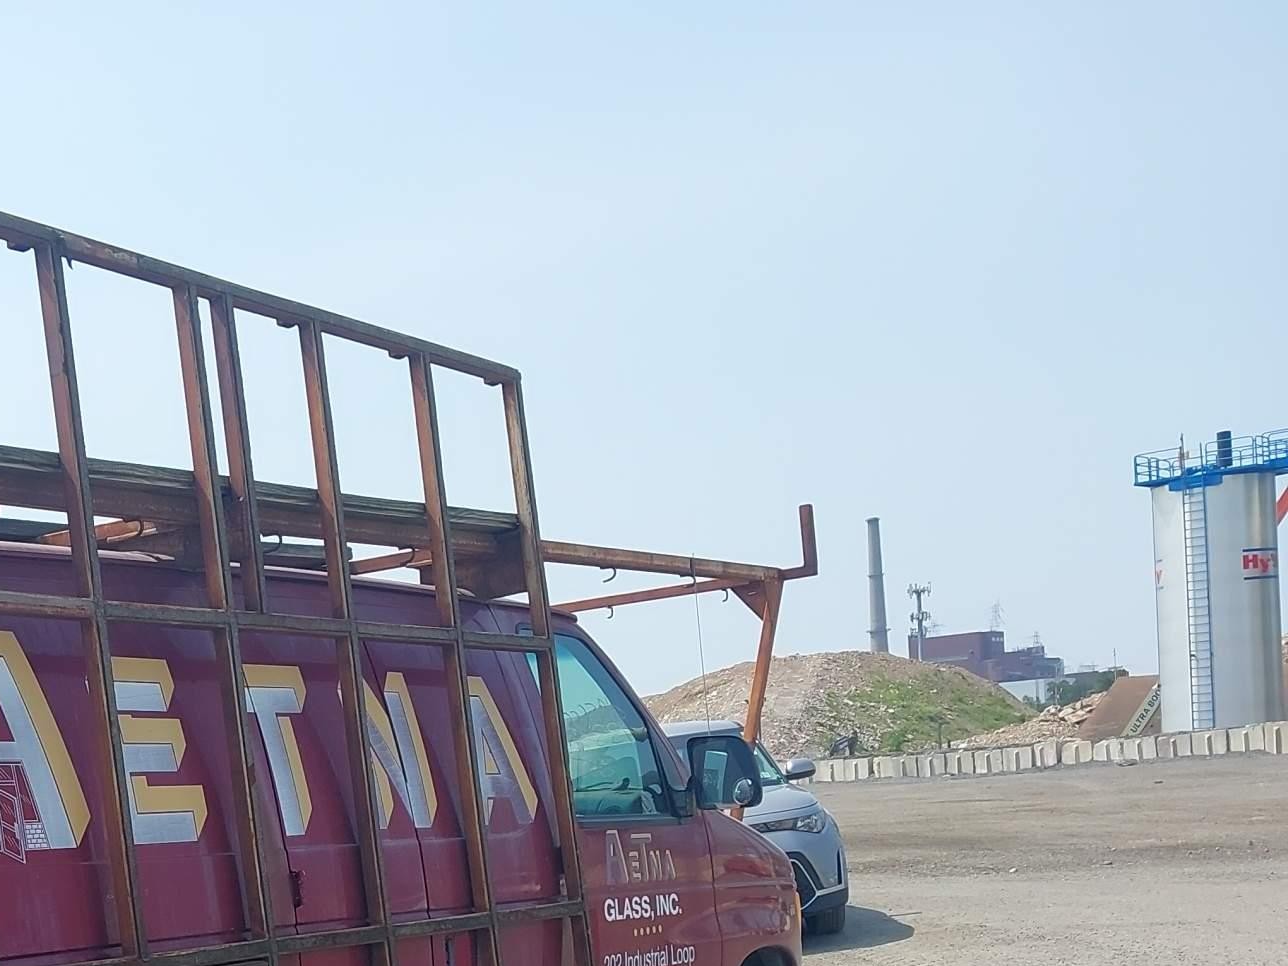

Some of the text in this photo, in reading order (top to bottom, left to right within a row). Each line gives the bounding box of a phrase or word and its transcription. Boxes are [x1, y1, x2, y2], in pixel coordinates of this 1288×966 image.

[1130, 708, 1150, 733] ULTRA
[604, 893, 683, 922] GLASS, INC.
